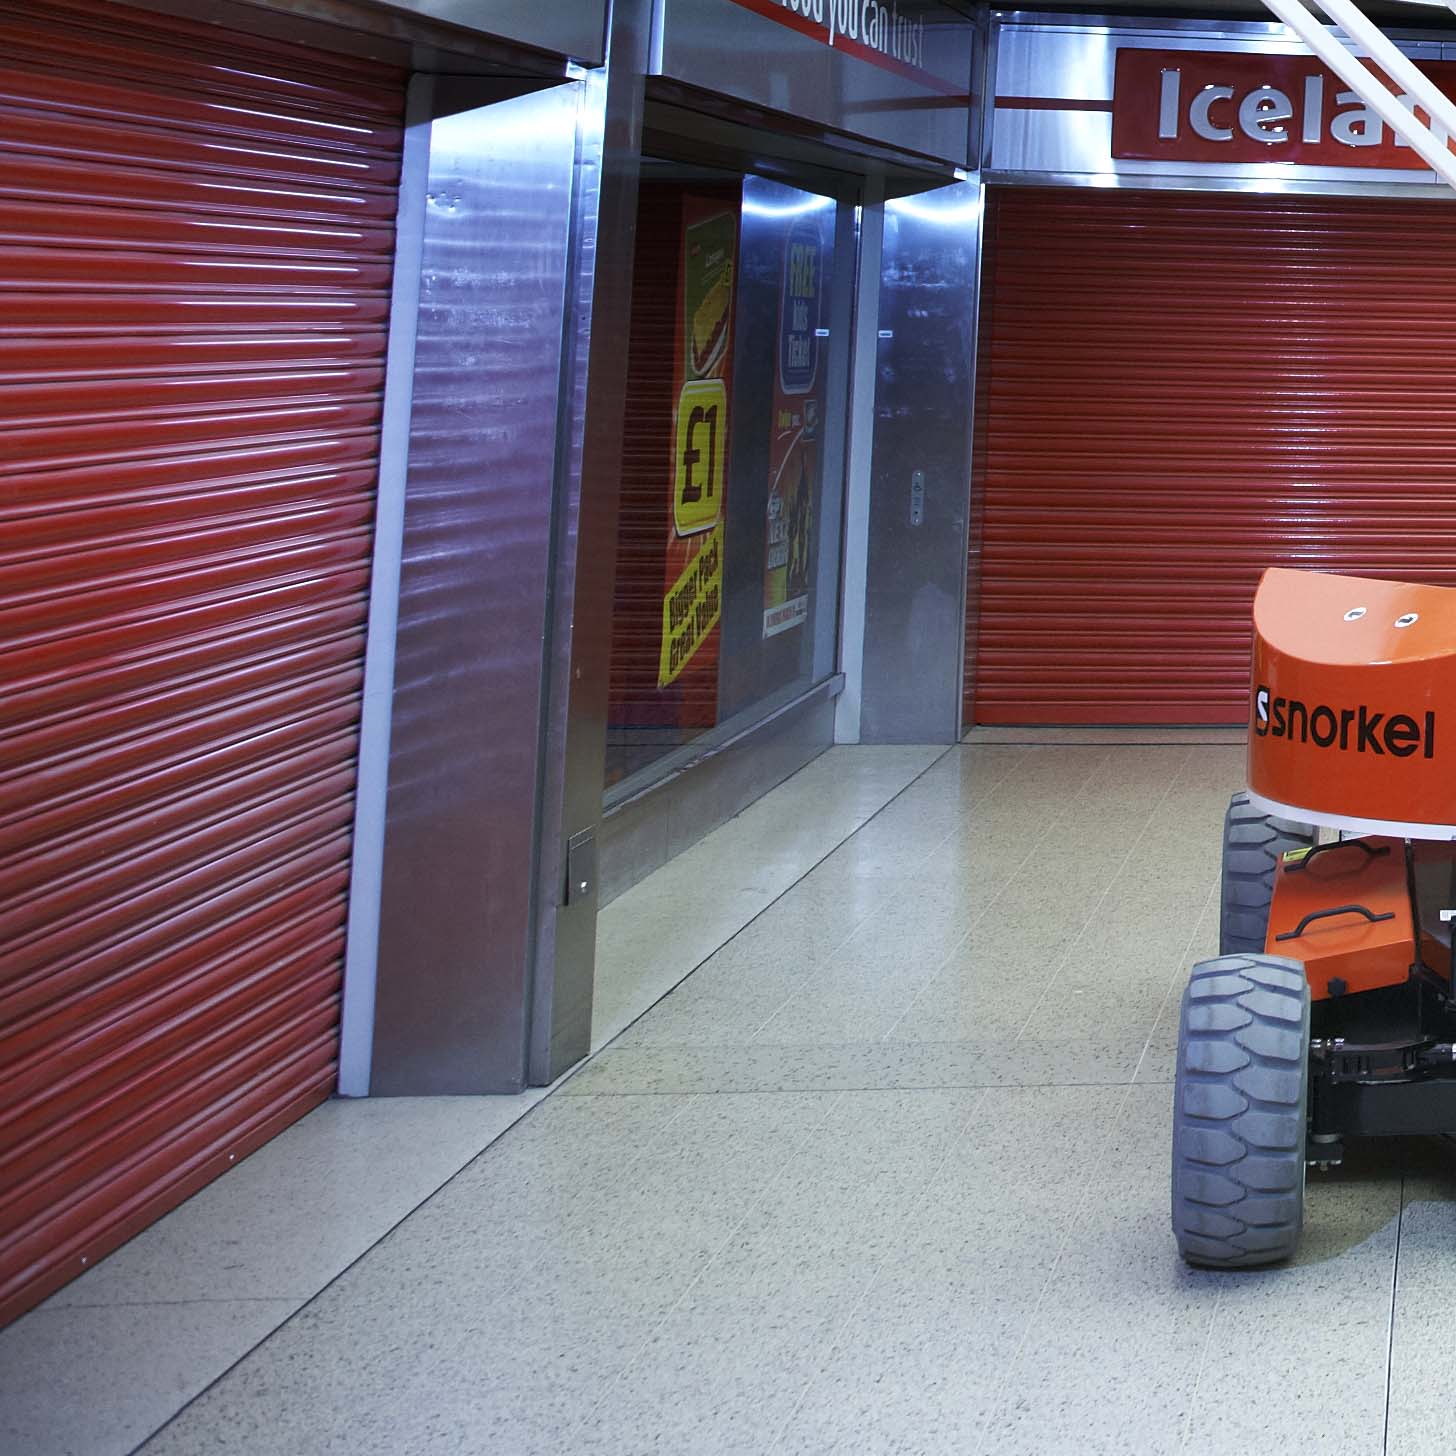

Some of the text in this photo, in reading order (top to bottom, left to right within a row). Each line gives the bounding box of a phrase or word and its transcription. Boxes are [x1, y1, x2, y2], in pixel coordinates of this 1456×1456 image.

[892, 0, 924, 68] trust
[682, 404, 718, 505] £1
[669, 538, 718, 634] Bigger Pack
[669, 583, 718, 676] Great Value
[1272, 696, 1435, 759] snorkel
